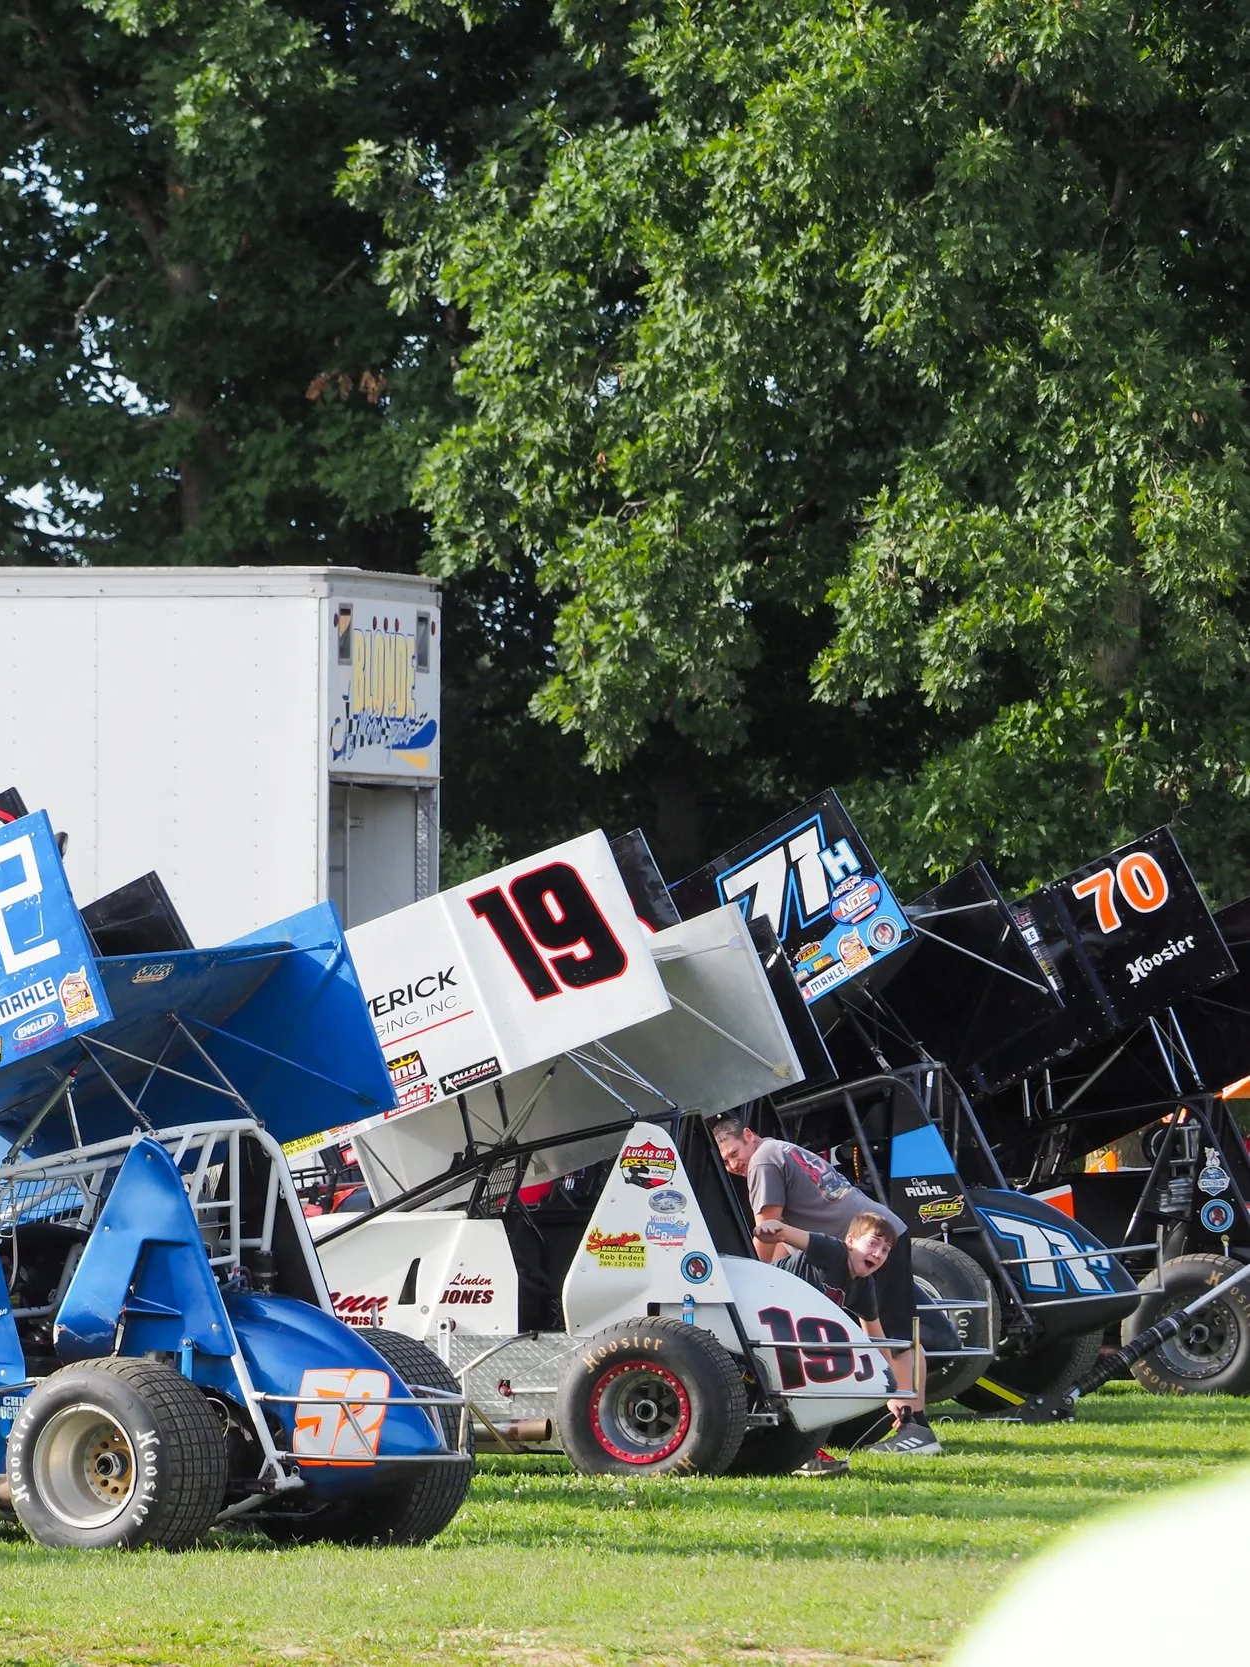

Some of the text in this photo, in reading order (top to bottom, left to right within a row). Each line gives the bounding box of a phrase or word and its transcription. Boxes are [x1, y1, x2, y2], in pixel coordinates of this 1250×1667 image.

[1072, 851, 1169, 934] 70
[466, 861, 628, 1001] 19
[1126, 935, 1195, 984] Hoosier
[367, 966, 458, 1018] ERICK
[811, 966, 844, 992] MAHLE
[427, 996, 461, 1017] INC.
[17, 1014, 56, 1039] ENGLER
[452, 1060, 497, 1081] ALLSTAR
[626, 1149, 669, 1159] LUCAS OIL
[920, 1203, 961, 1212] SLADE
[449, 1272, 493, 1286] Linden
[439, 1289, 495, 1305] JONES
[582, 1332, 663, 1374] Hoosier
[293, 1368, 391, 1467] 52
[11, 1406, 35, 1504] Hoosier
[132, 1429, 161, 1527] Hoosier
